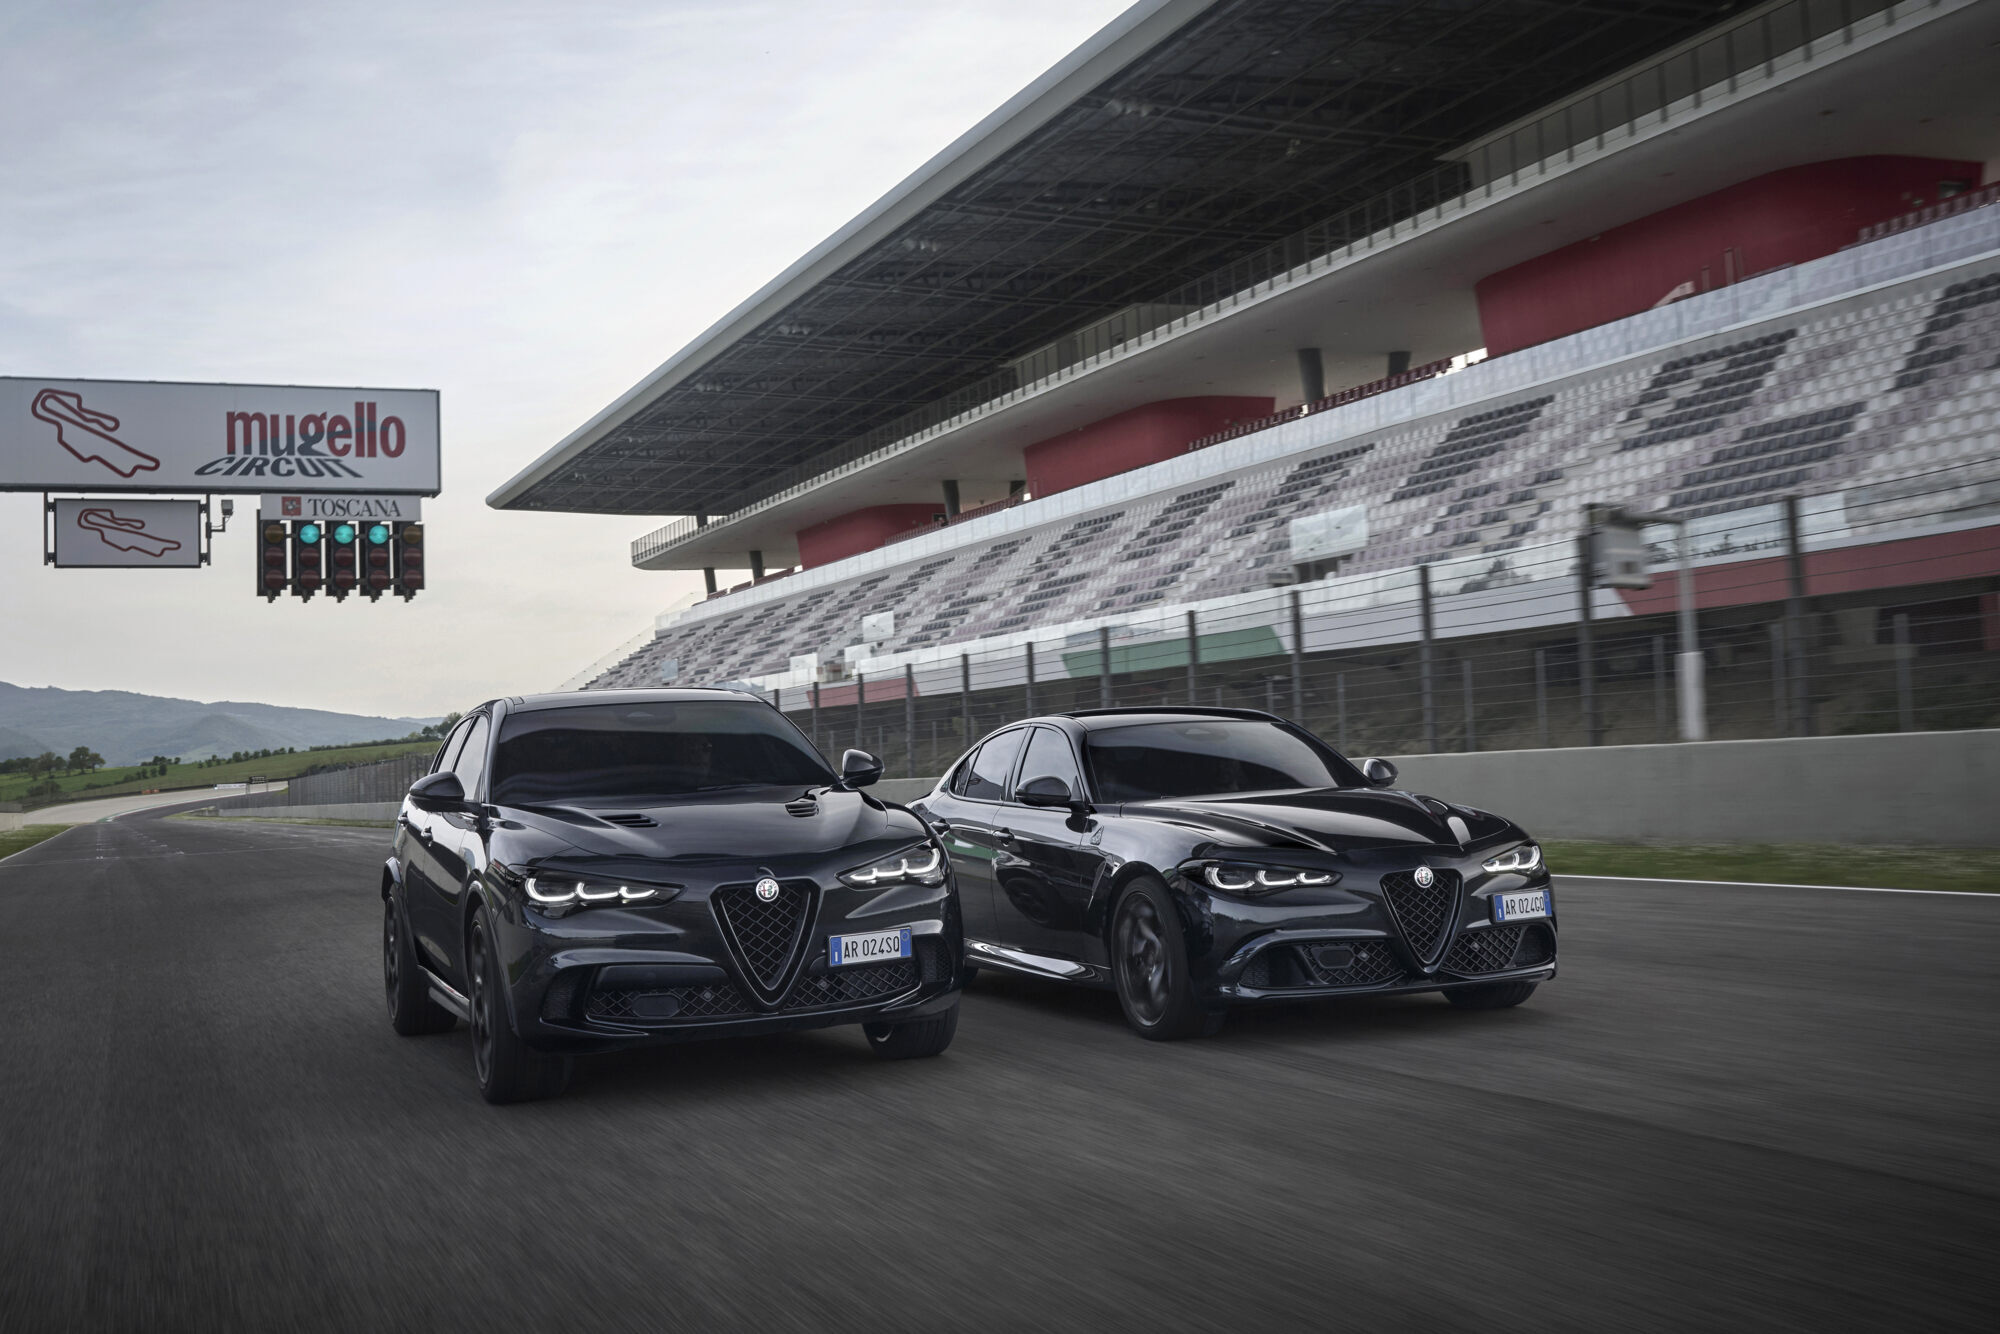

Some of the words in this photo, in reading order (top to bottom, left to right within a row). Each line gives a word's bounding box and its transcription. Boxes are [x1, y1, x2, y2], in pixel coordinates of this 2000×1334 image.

[226, 401, 406, 458] mugello
[194, 457, 364, 478] CIRCUIT
[307, 499, 402, 517] TOSCANA
[1505, 899, 1516, 915] AR
[844, 941, 858, 958] AR
[862, 936, 900, 956] 024SQ
